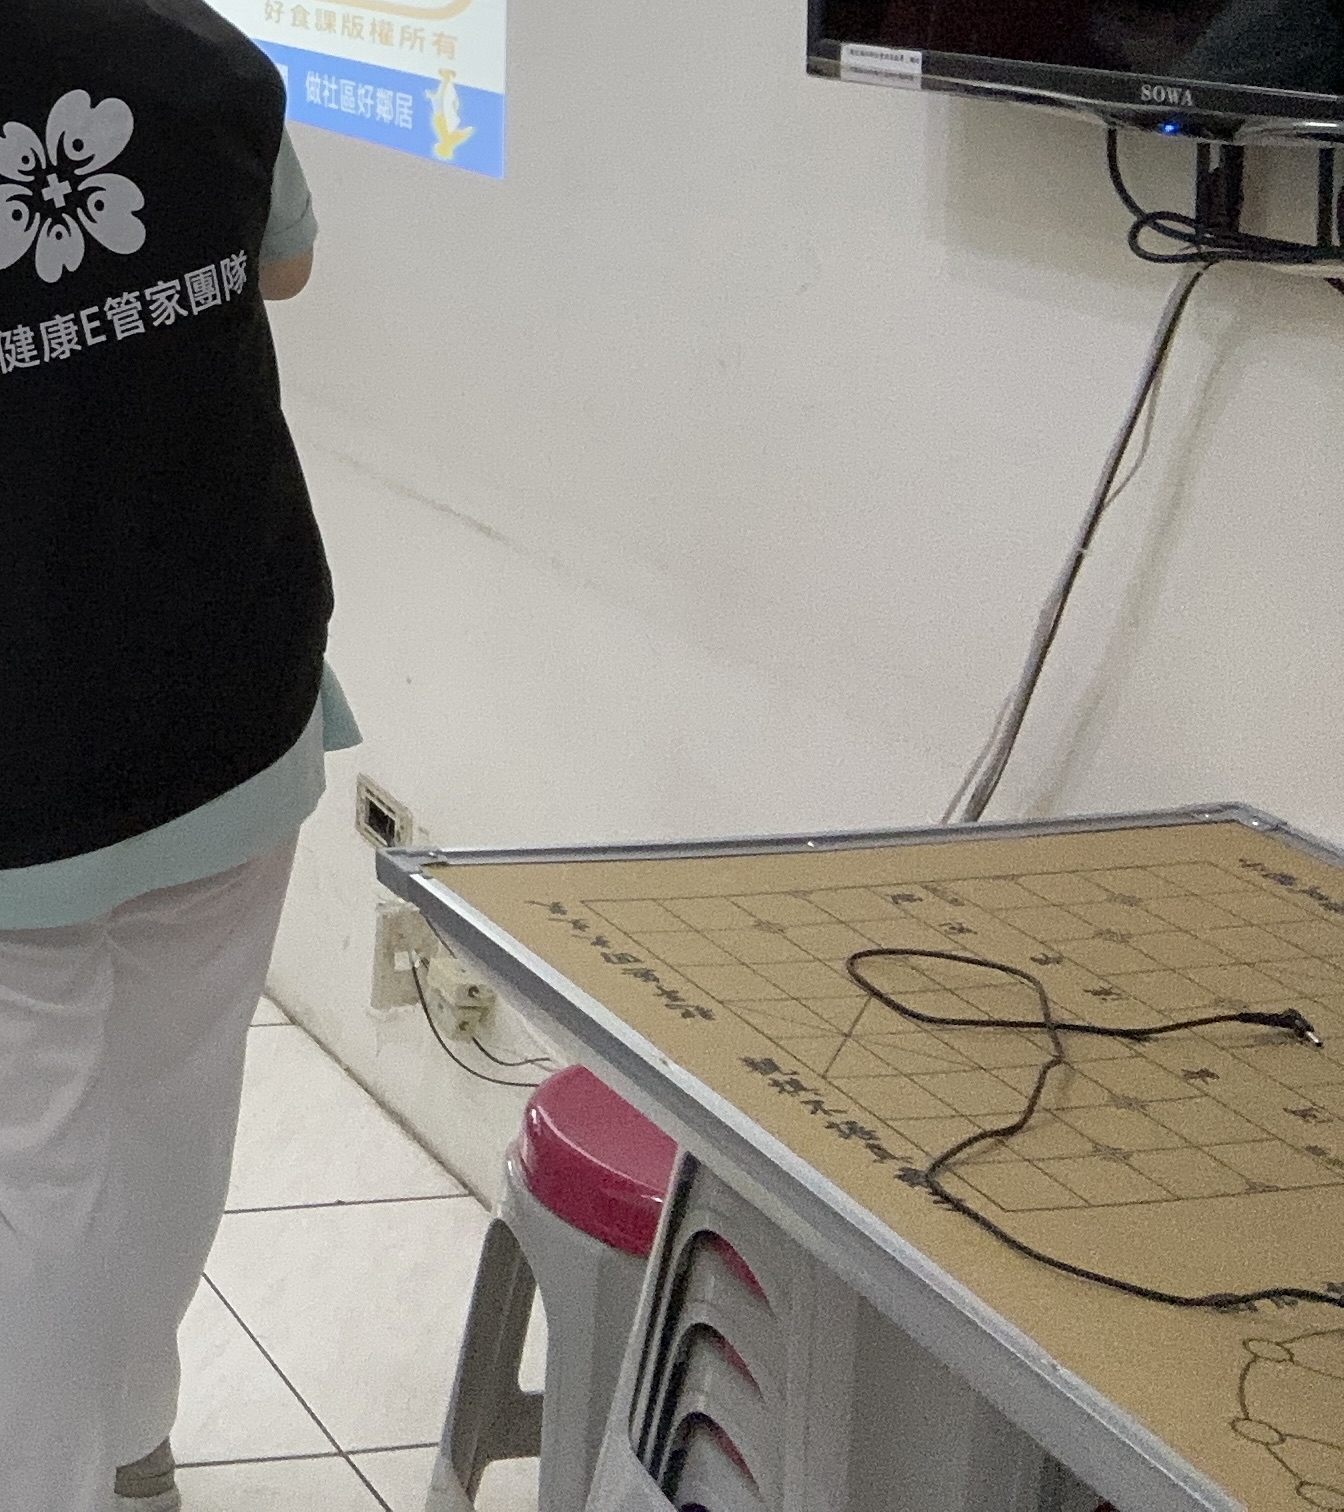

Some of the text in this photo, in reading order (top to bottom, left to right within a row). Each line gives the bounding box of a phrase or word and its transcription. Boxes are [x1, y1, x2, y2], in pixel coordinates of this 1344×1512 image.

[265, 0, 458, 60] 好食課版權所有
[305, 71, 414, 130] 做社區好鄰居
[1141, 85, 1193, 107] SOWA
